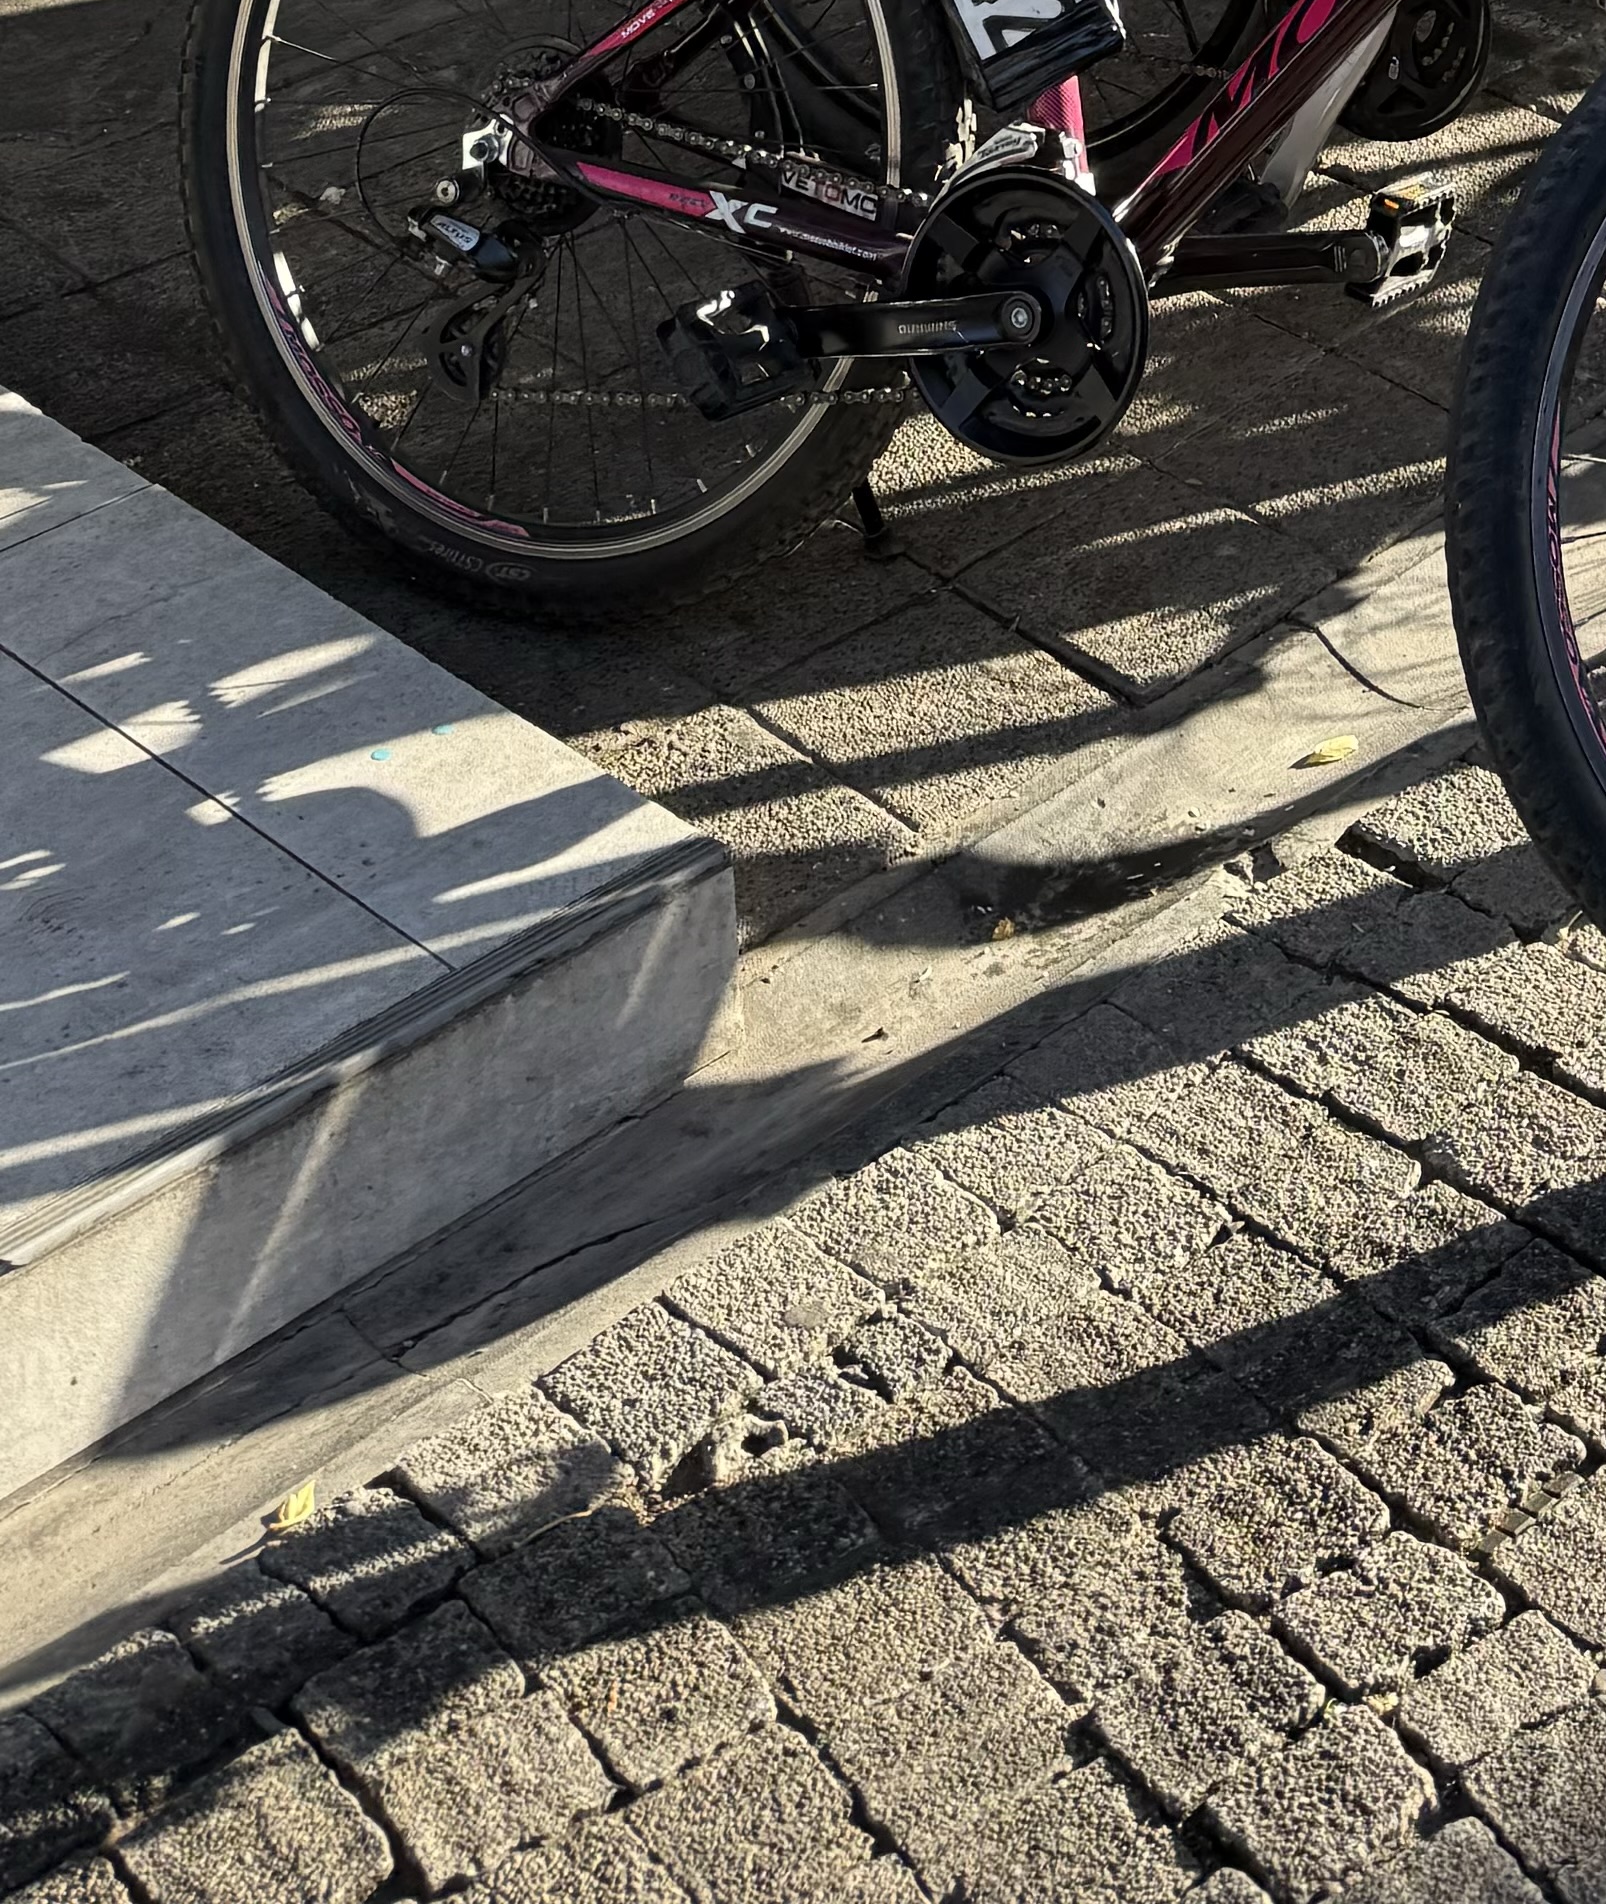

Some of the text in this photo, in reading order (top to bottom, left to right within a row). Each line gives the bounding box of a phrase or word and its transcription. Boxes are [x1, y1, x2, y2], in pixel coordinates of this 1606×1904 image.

[621, 8, 656, 39] MOVE
[705, 190, 779, 234] XC
[436, 222, 473, 244] ALTUS
